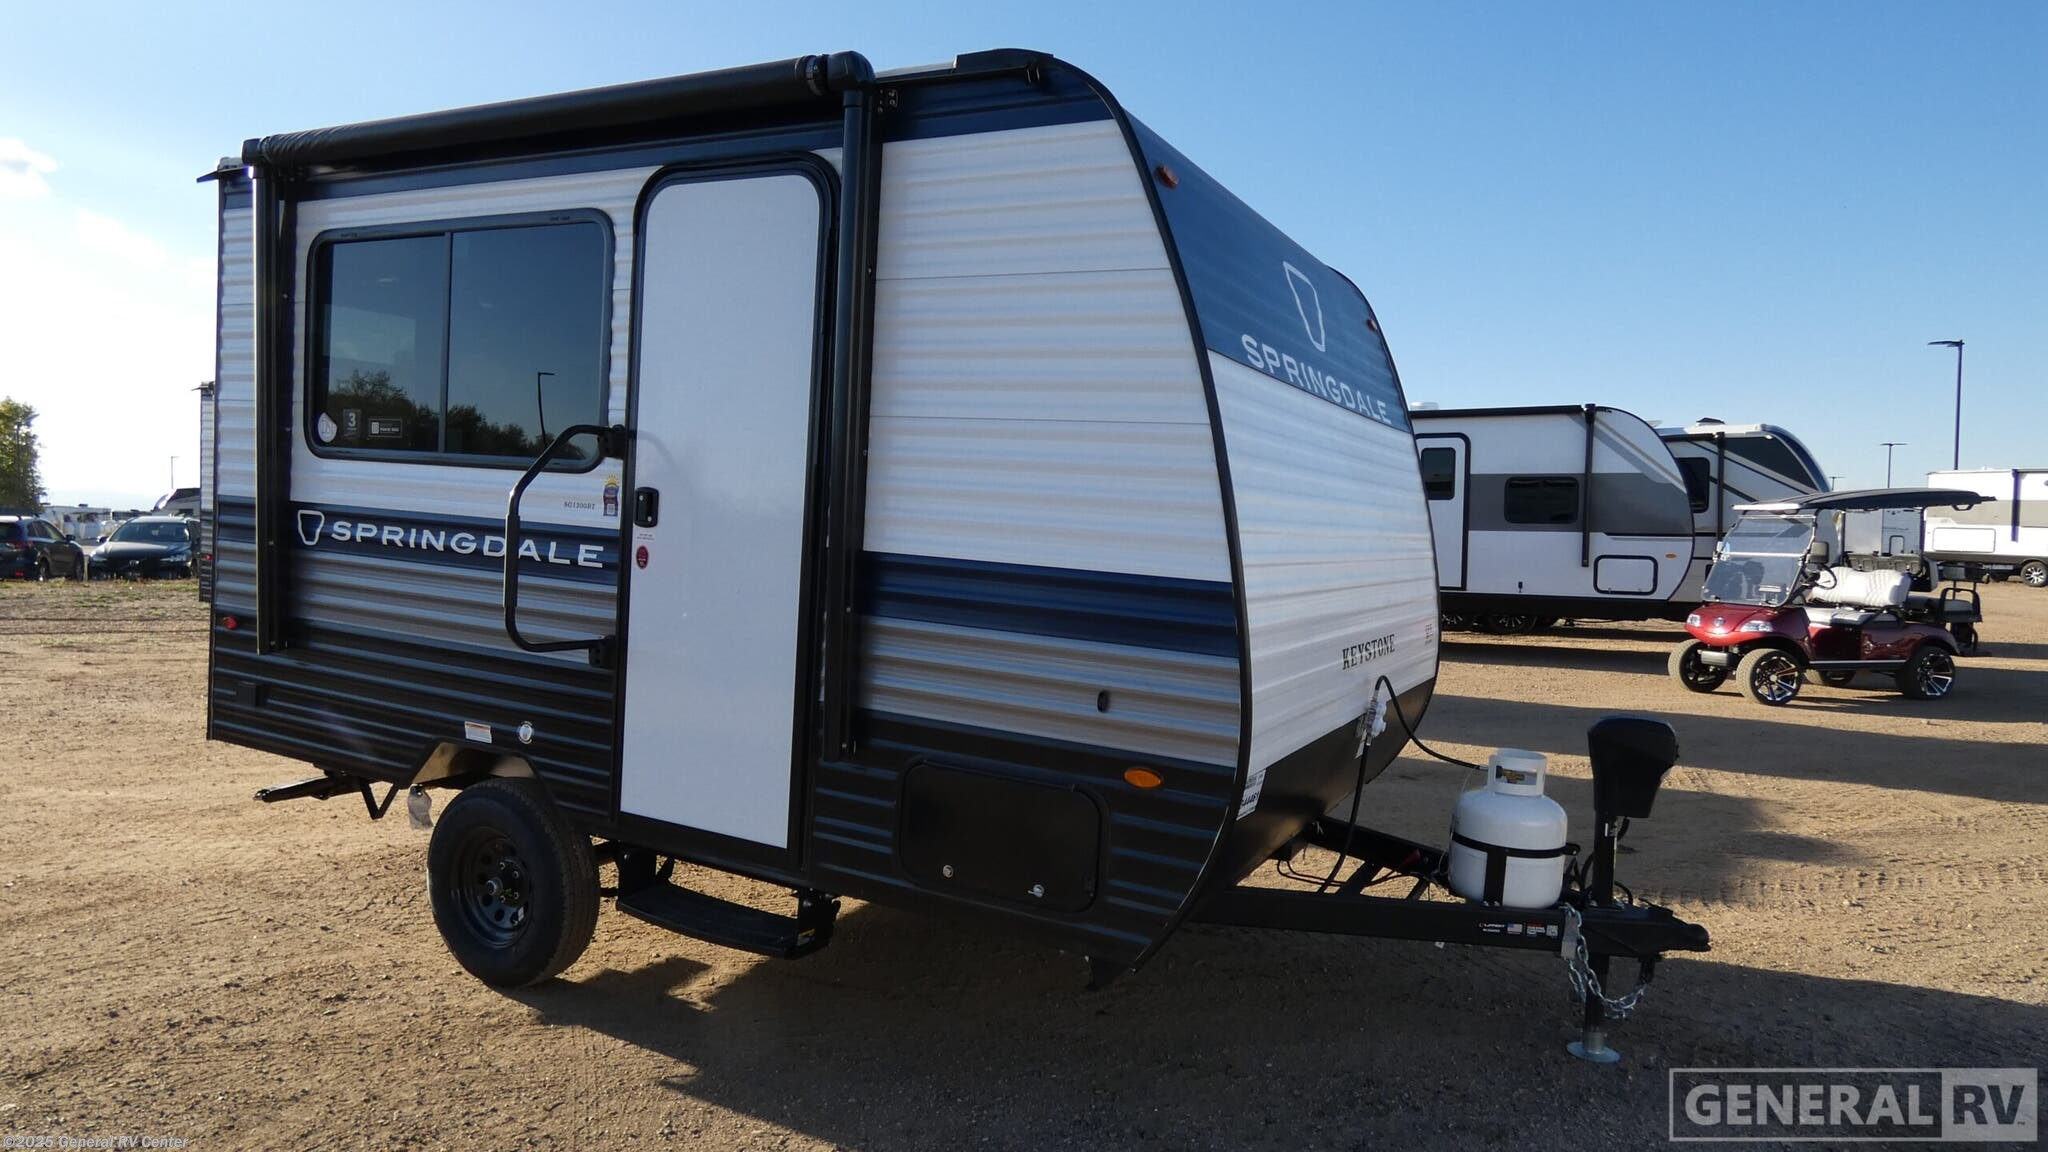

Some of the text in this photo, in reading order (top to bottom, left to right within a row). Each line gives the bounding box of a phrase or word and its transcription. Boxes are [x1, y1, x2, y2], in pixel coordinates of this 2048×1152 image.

[1241, 334, 1392, 424] SPRINGDALE
[331, 520, 604, 569] SPRINGDALE
[1342, 634, 1396, 670] KEYSTONE
